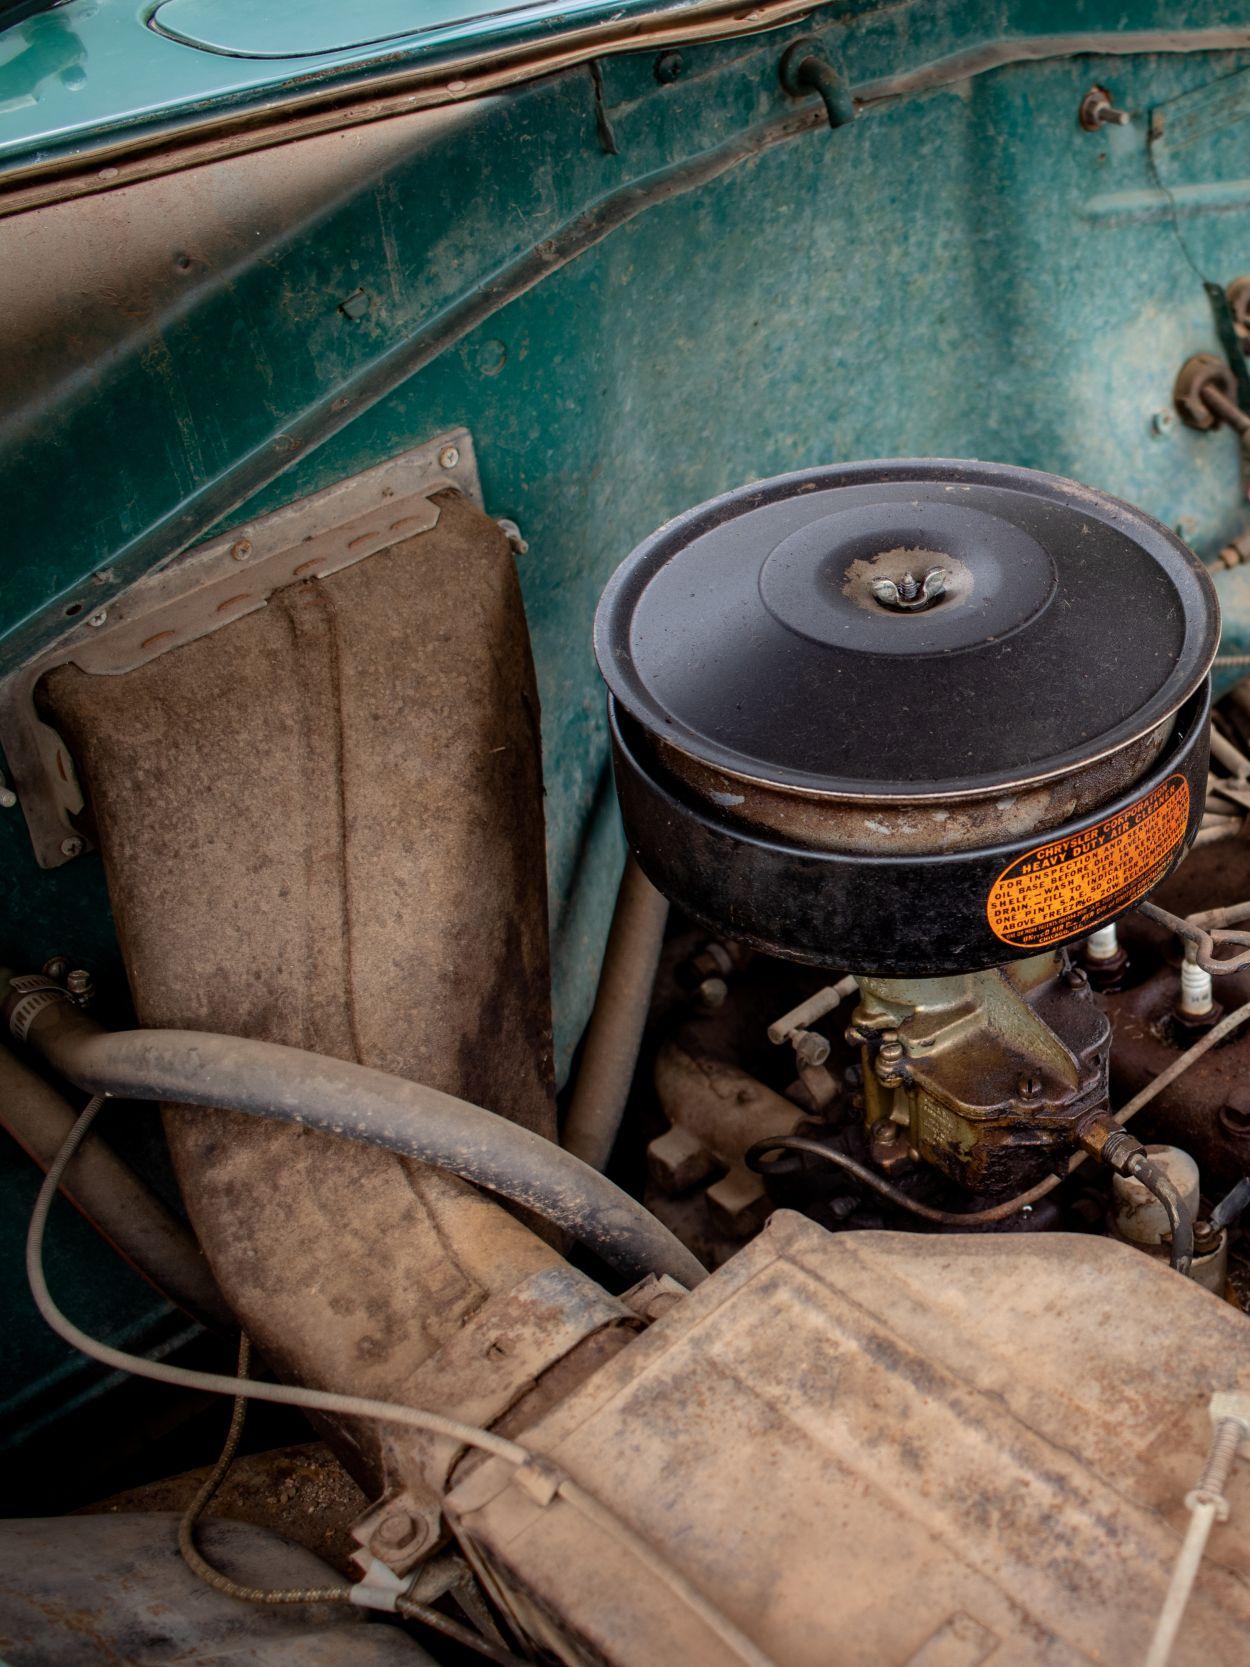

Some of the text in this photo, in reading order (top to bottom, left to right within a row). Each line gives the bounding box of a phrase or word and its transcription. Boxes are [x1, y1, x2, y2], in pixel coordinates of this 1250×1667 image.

[1021, 782, 1175, 875] HEAVY DUTY AIR CLEANER
[1036, 781, 1168, 861] CHRYSLER CORPORATION
[1081, 859, 1113, 881] FILTER
[1119, 850, 1129, 861] IN
[1133, 811, 1174, 852] KEROSENE
[994, 890, 1011, 900] OIL
[1018, 879, 1044, 895] BASE
[1050, 863, 1088, 885] BEFORE
[1094, 850, 1114, 866] DIRT
[1118, 833, 1141, 853] LEVEL
[1145, 819, 1158, 836] HAS
[995, 914, 1017, 924] ONE
[1024, 901, 1052, 918] PINT
[1059, 888, 1087, 906] S.A.E.
[1106, 872, 1119, 885] OIL
[1123, 860, 1138, 876] FOR
[999, 879, 1022, 890] FOR
[1029, 849, 1098, 885] INSPECTION
[1103, 837, 1122, 853] AND
[1069, 882, 1082, 894] TO
[1087, 856, 1133, 887] INDICATED
[1137, 842, 1150, 858] OIL
[1153, 822, 1172, 847] LEVEL
[1002, 914, 1040, 931] ABOVE
[1042, 892, 1096, 922] FREEZG.
[1123, 859, 1149, 883] BELOW
[1051, 921, 1065, 934] AIR
